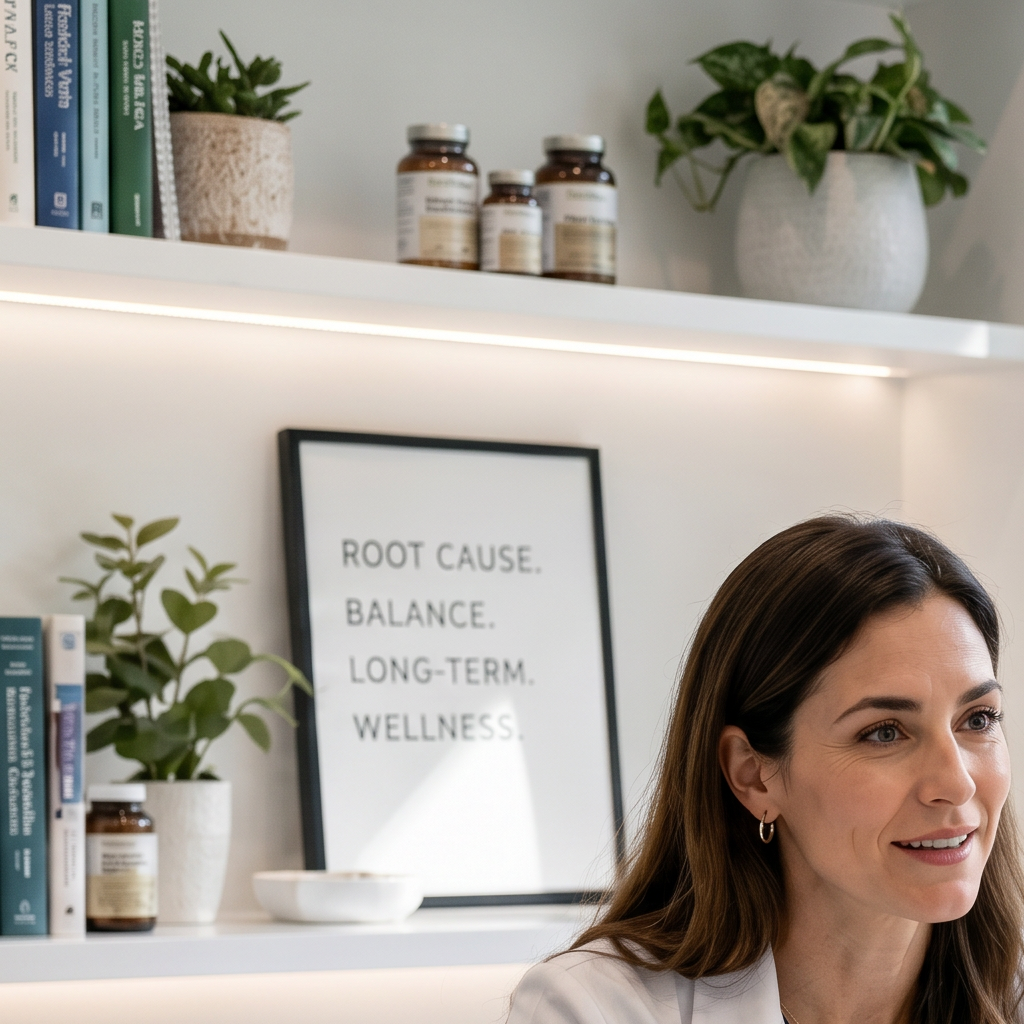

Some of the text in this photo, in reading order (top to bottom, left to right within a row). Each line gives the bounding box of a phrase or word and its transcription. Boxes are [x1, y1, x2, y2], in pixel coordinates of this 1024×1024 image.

[342, 539, 542, 574] ROOT CAUSE.
[346, 598, 495, 629] BALANCE.
[350, 655, 535, 686] LONG-TERM.
[353, 713, 524, 742] WELLNESS.
